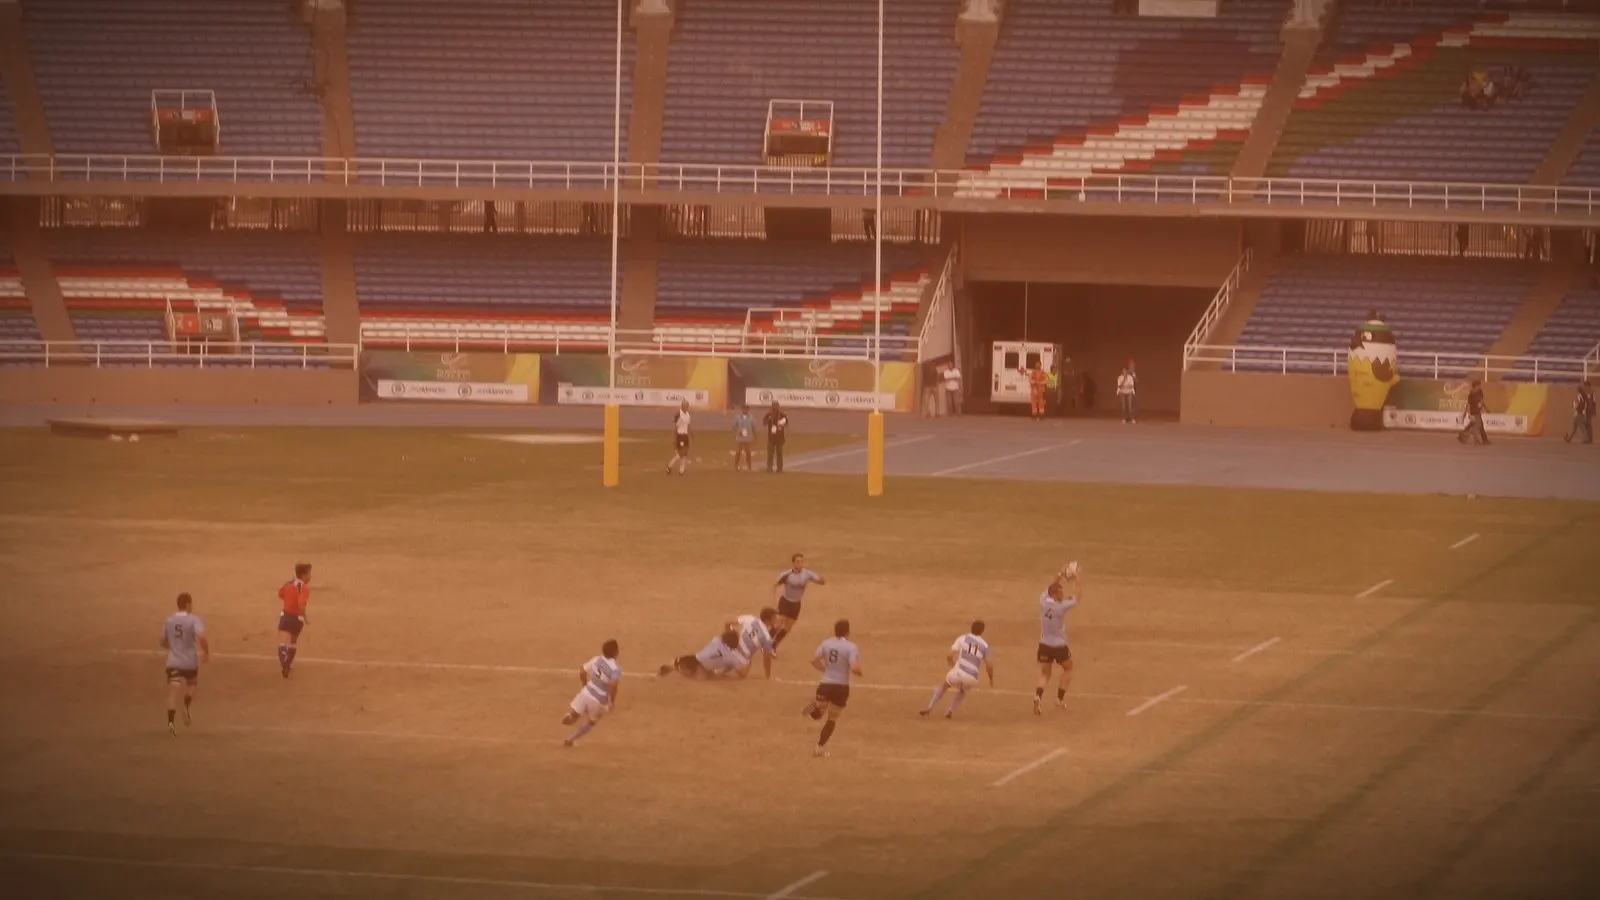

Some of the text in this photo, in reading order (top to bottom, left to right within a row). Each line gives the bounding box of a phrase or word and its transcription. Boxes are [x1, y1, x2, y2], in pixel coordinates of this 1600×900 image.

[1044, 607, 1053, 621] 4
[174, 623, 184, 639] 5
[829, 648, 839, 664] 8
[967, 642, 979, 657] 11
